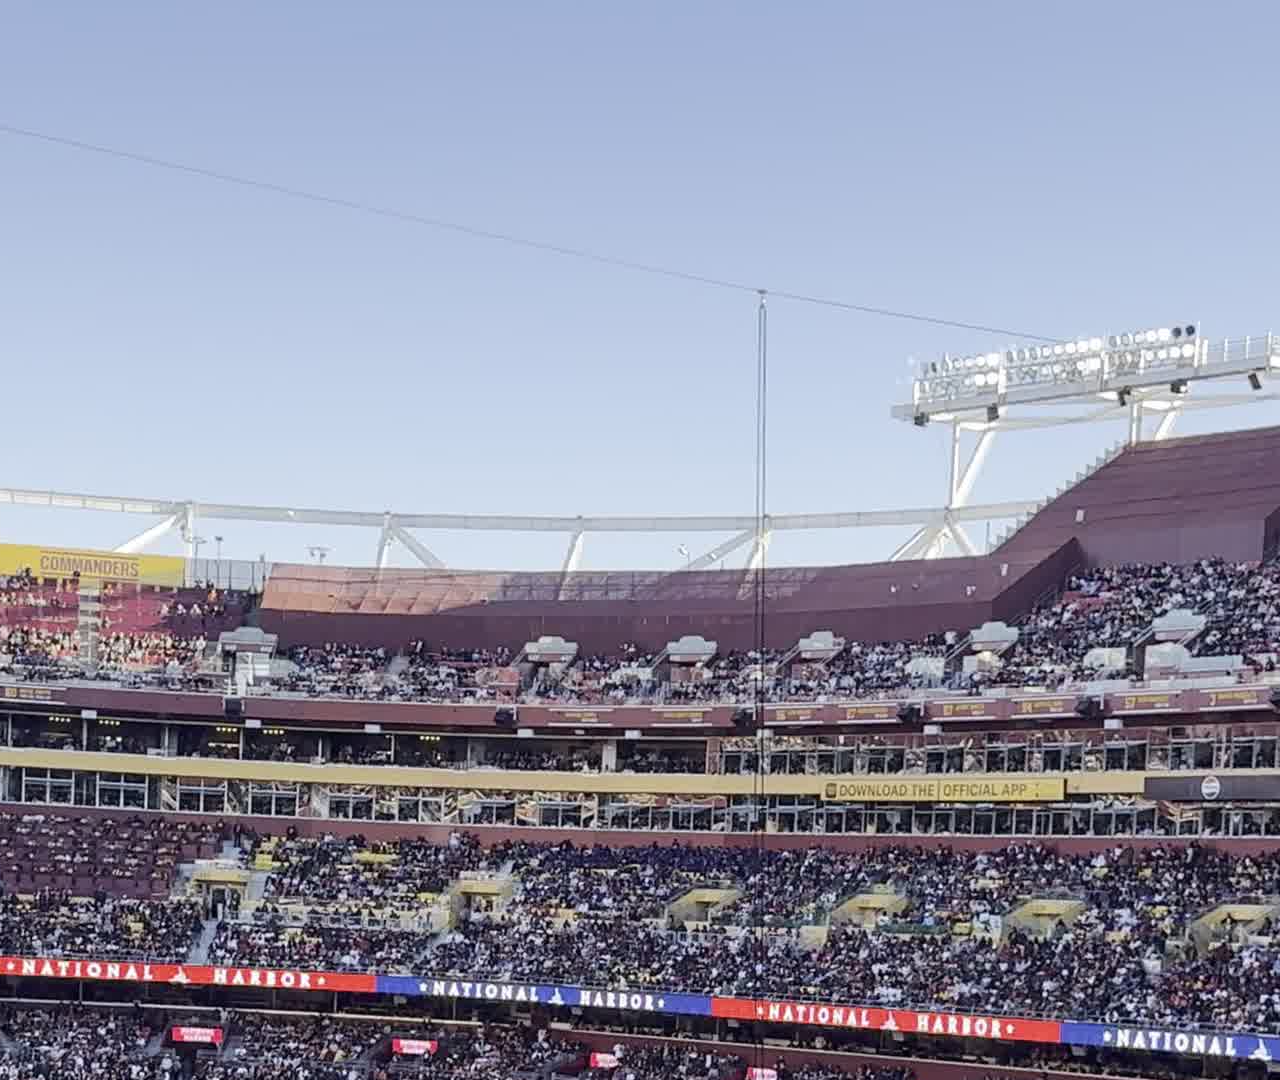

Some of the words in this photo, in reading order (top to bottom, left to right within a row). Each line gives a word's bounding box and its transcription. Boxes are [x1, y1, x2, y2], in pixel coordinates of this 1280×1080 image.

[40, 555, 139, 577] COMMANDERS
[839, 784, 907, 798] DOWNLOAD
[912, 783, 934, 797] THE
[943, 782, 998, 797] OFFICIAL
[1001, 782, 1027, 796] APP
[21, 960, 153, 981] NATIONAL
[214, 968, 312, 988] HARBOR
[433, 980, 541, 1003] NATIONAL
[581, 990, 654, 1010] HARBOR
[769, 1003, 871, 1028] NATIONAL
[917, 1014, 1002, 1038] HARBOR
[1116, 1028, 1237, 1056] NATIONAL
